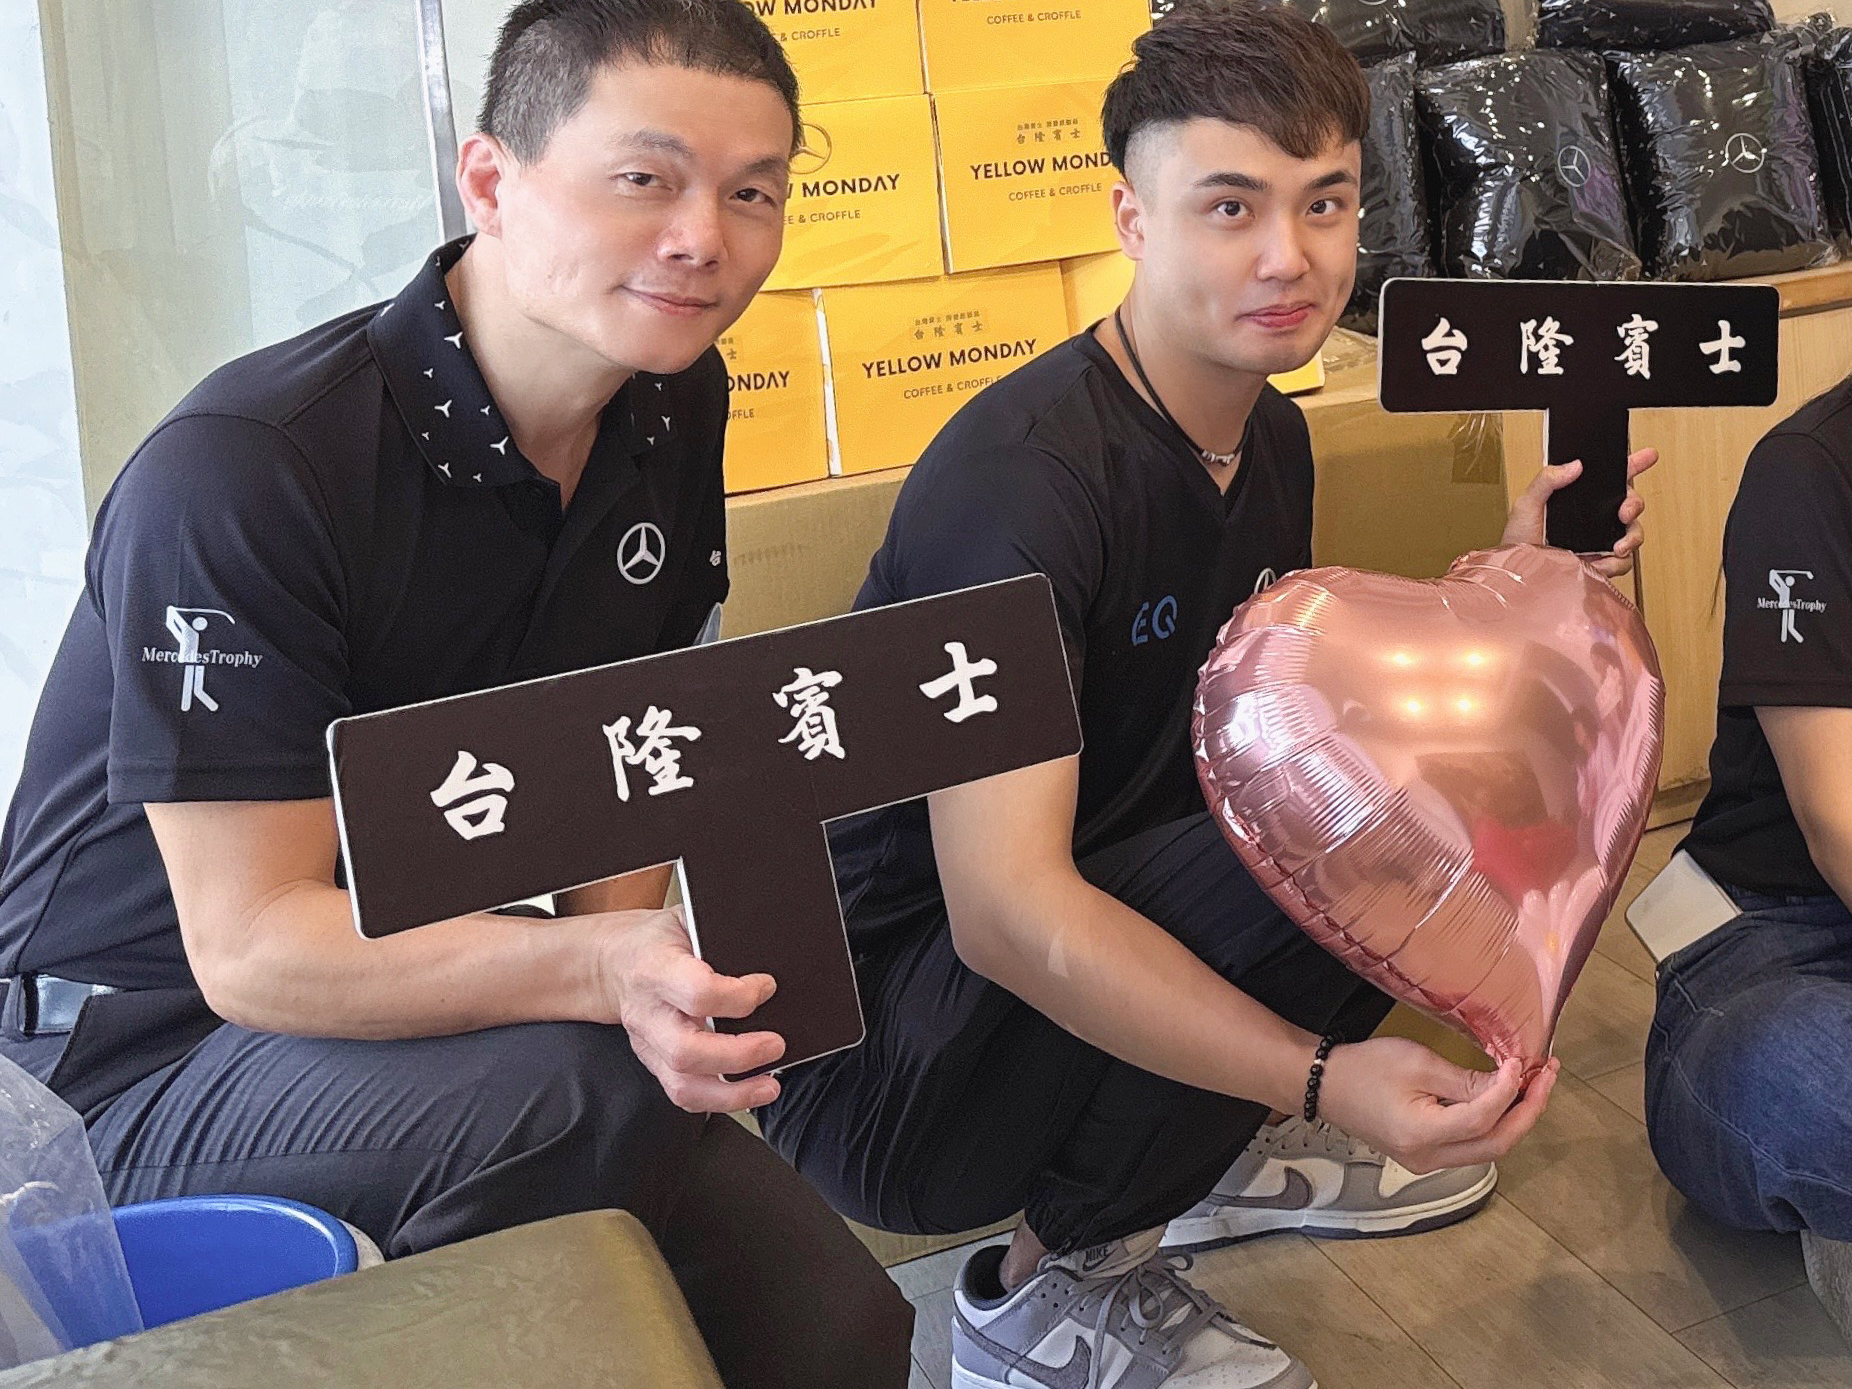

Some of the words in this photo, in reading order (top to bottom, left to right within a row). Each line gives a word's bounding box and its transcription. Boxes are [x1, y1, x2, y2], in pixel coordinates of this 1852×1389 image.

[986, 13, 1025, 25] COFFEE
[1027, 13, 1034, 22] &
[1037, 10, 1082, 22] CROFFLE
[780, 32, 788, 42] &
[791, 27, 841, 40] CROFFLE
[970, 157, 1045, 180] YELLOW
[1052, 151, 1112, 172] MOND
[802, 174, 900, 198] MONDAY
[1008, 188, 1046, 202] COFFEE
[1049, 187, 1056, 197] &
[1058, 183, 1102, 196] CROFFLE
[799, 214, 807, 223] &
[810, 209, 861, 222] CROFFLE
[913, 320, 983, 341] 台隆賓士
[1419, 312, 1747, 381] 台隆賓士
[862, 352, 942, 379] YELLOW
[950, 339, 1037, 367] MONDAY
[727, 371, 790, 392] ONDAY
[903, 384, 943, 399] COFFEE
[946, 383, 954, 393] &
[1757, 597, 1827, 613] MercsTrophy
[1132, 595, 1178, 646] EQ
[142, 647, 263, 668] MercesTrophy
[429, 641, 1000, 842] 台隆賓士
